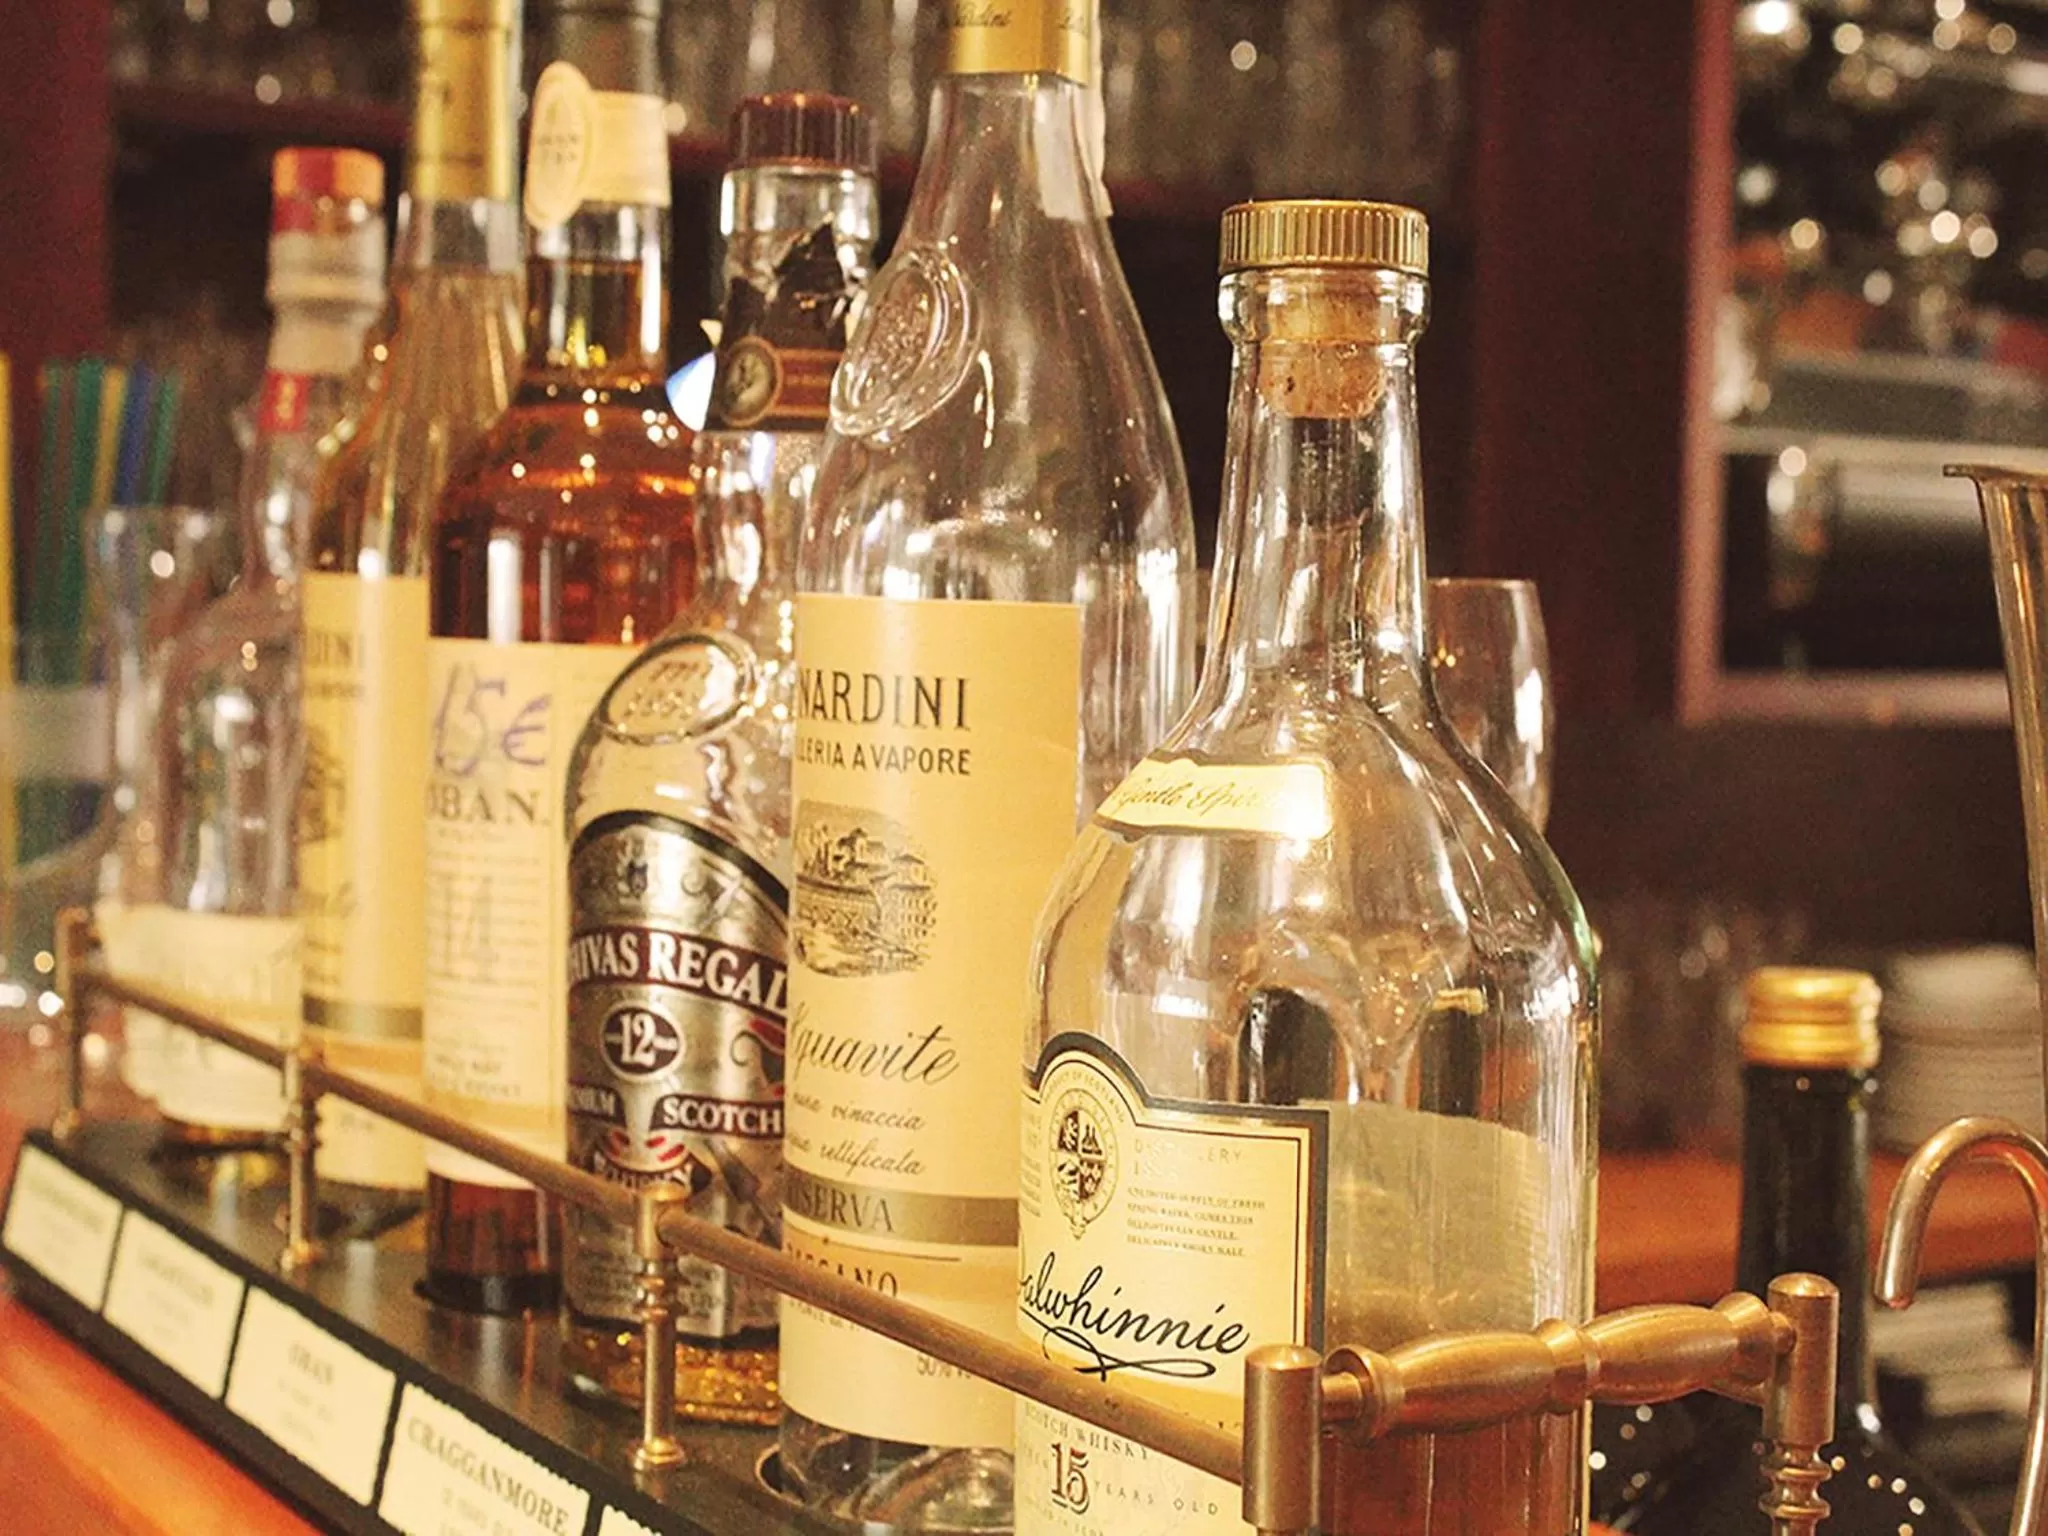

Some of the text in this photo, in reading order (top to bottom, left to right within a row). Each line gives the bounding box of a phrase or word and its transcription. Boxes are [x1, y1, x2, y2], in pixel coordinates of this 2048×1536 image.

[799, 667, 972, 731] NARDINI
[851, 742, 868, 770] A
[869, 745, 972, 777] VAPORE
[646, 931, 788, 1016] REGAL
[662, 1096, 782, 1134] SCOTCH
[831, 1098, 926, 1132] vinaccia
[1017, 1251, 1251, 1355] alwhinnie
[406, 1415, 570, 1534] CRAGGANMORE
[1050, 1440, 1091, 1516] 15
[1173, 1498, 1219, 1516] OLD
